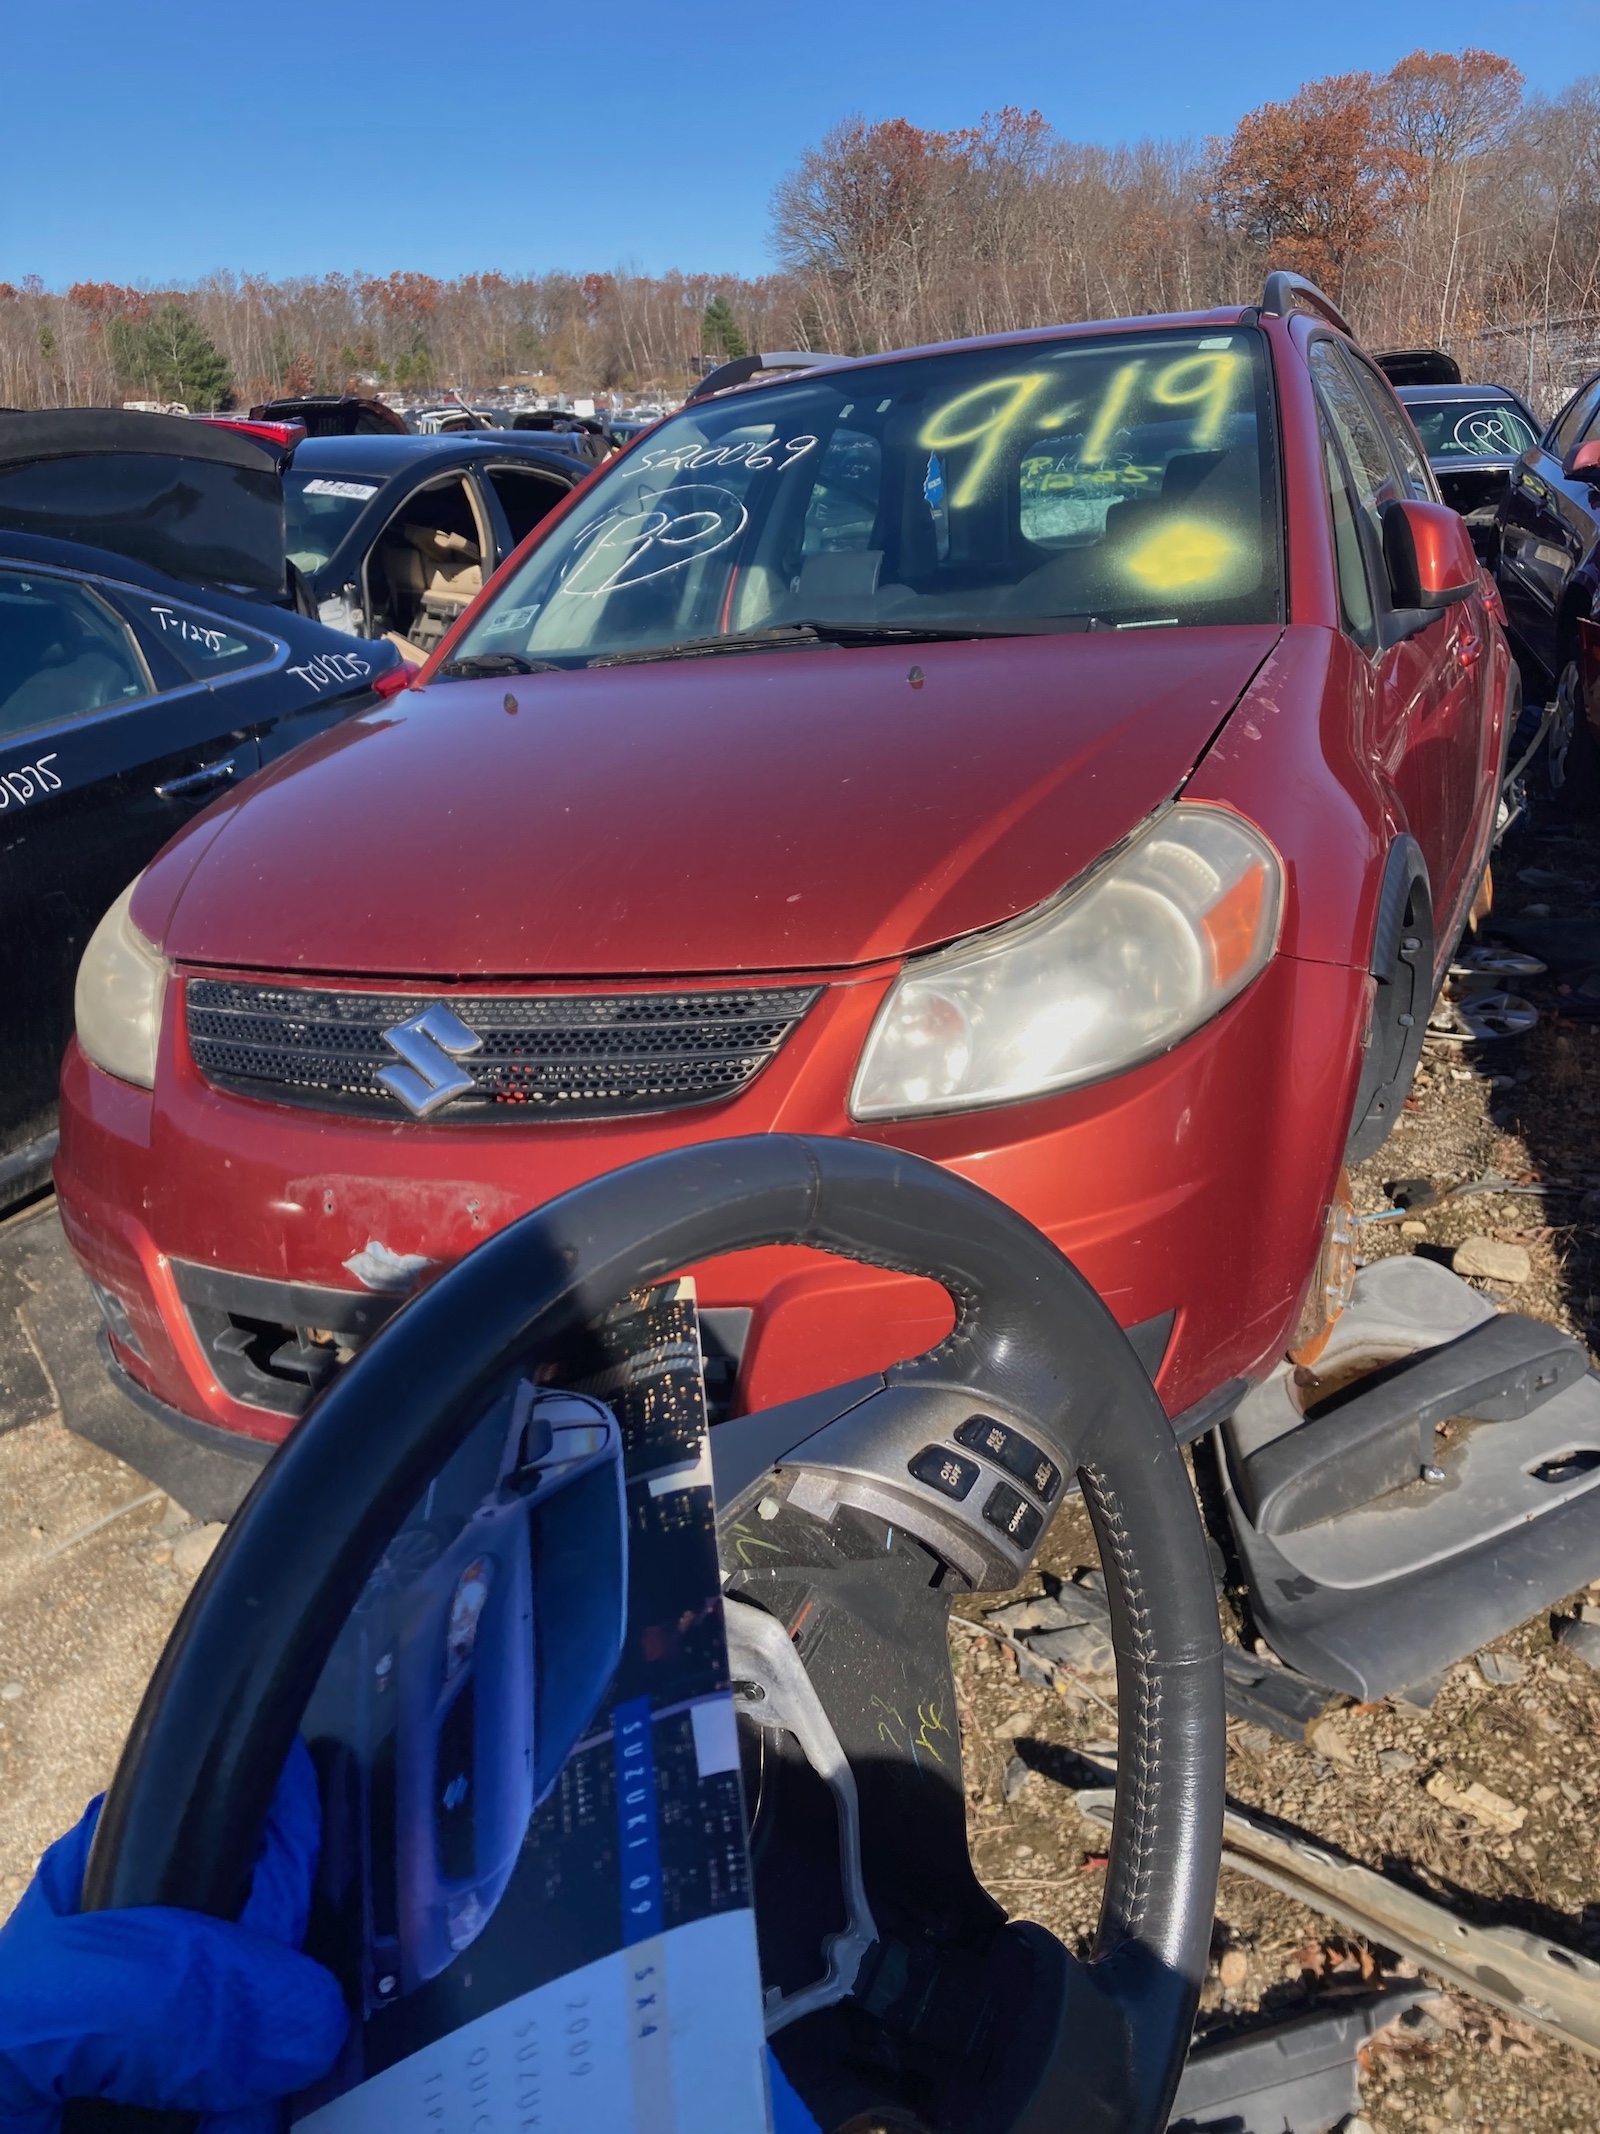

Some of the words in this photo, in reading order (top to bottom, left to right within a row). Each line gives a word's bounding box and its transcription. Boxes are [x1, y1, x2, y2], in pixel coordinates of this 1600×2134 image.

[622, 434, 819, 478] S20069
[150, 606, 227, 652] T-1275
[285, 652, 371, 693] T01275
[986, 1428, 1000, 1448] RES
[992, 1433, 1007, 1453] ACC
[940, 1461, 953, 1480] ON
[948, 1464, 962, 1486] OFF
[1008, 1501, 1029, 1533] CANCEL
[622, 1720, 650, 1850] SUZUKI
[630, 1873, 653, 1917] 09
[565, 1996, 593, 2078] 2009
